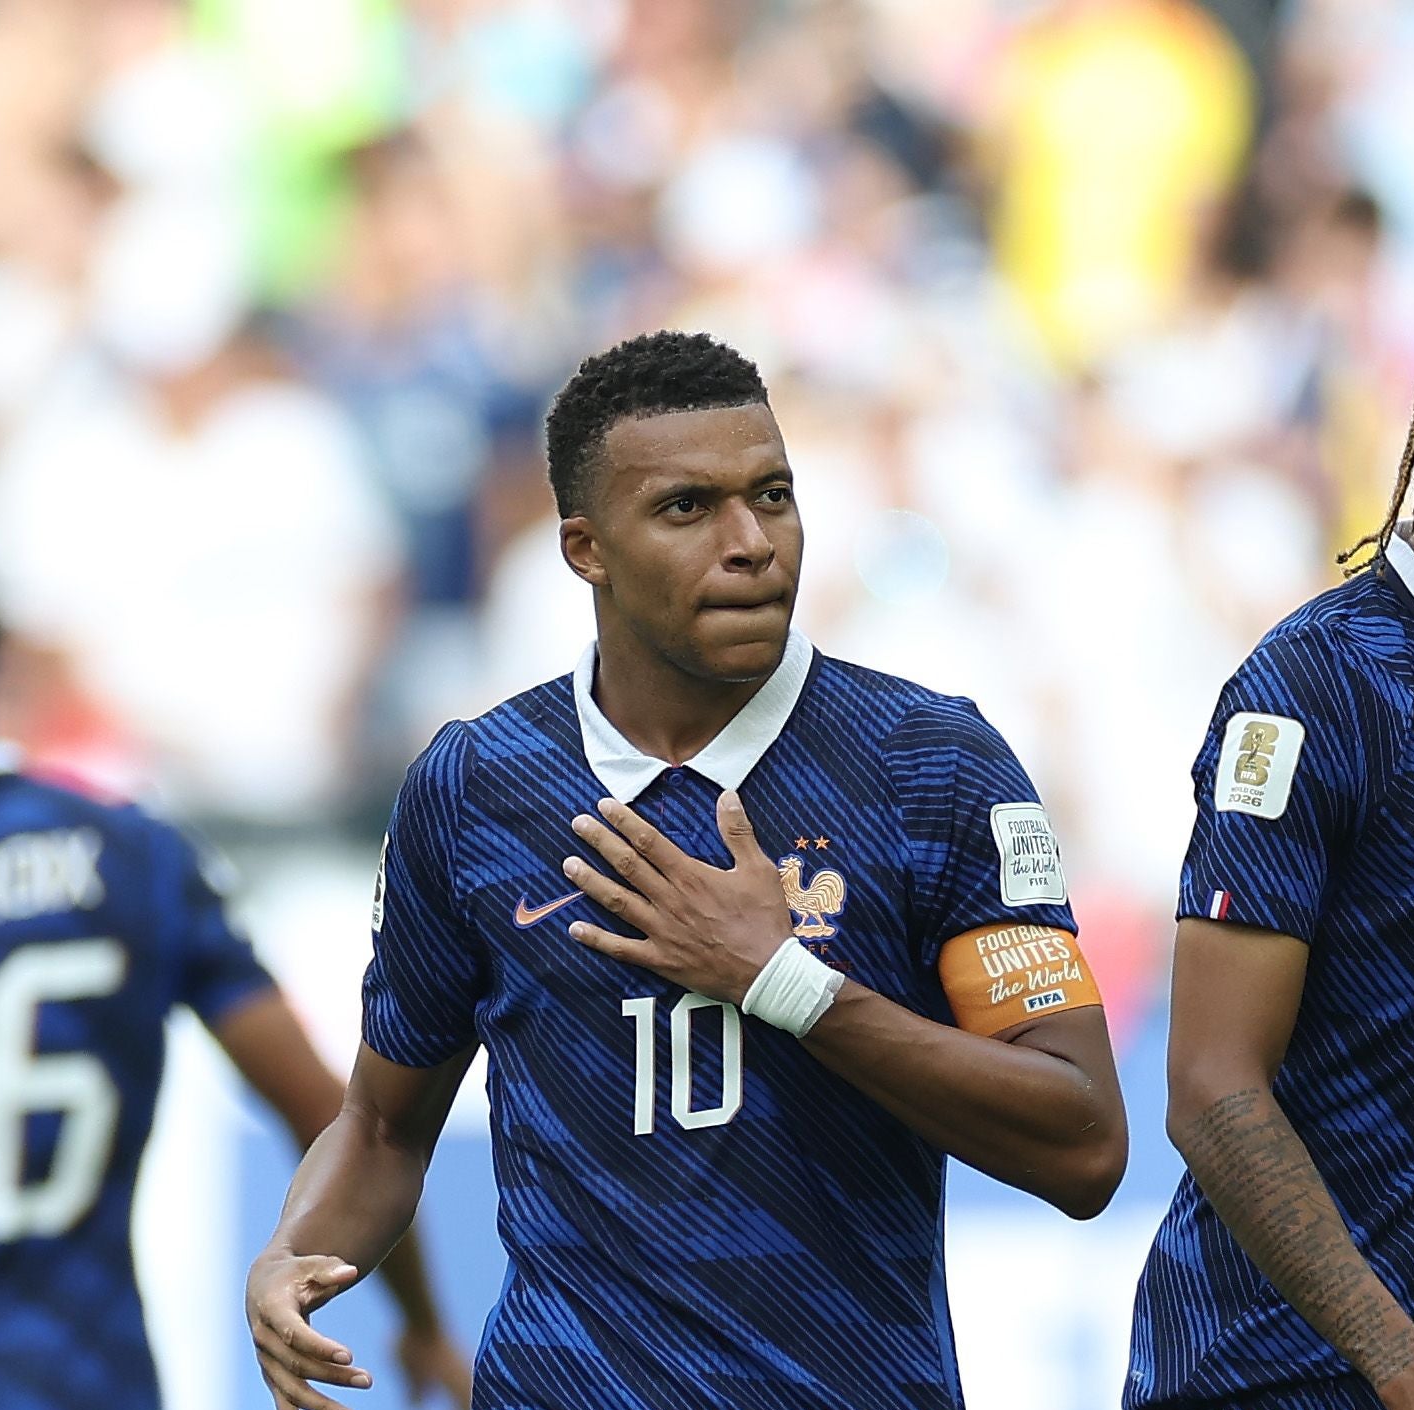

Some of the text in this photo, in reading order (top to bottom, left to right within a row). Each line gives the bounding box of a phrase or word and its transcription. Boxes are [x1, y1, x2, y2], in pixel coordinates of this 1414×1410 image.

[1227, 793, 1263, 808] 2026
[1249, 787, 1265, 797] CUP
[1008, 820, 1049, 834] FOOTBALL
[1012, 835, 1052, 856] UNITES
[1011, 858, 1031, 876] the
[1029, 877, 1049, 887] FIFA
[976, 924, 1059, 955] FOOTBALL
[982, 937, 1070, 978] UNITES
[987, 960, 1083, 1004] the World
[1028, 992, 1063, 1009] FIFA
[622, 993, 744, 1136] 10
